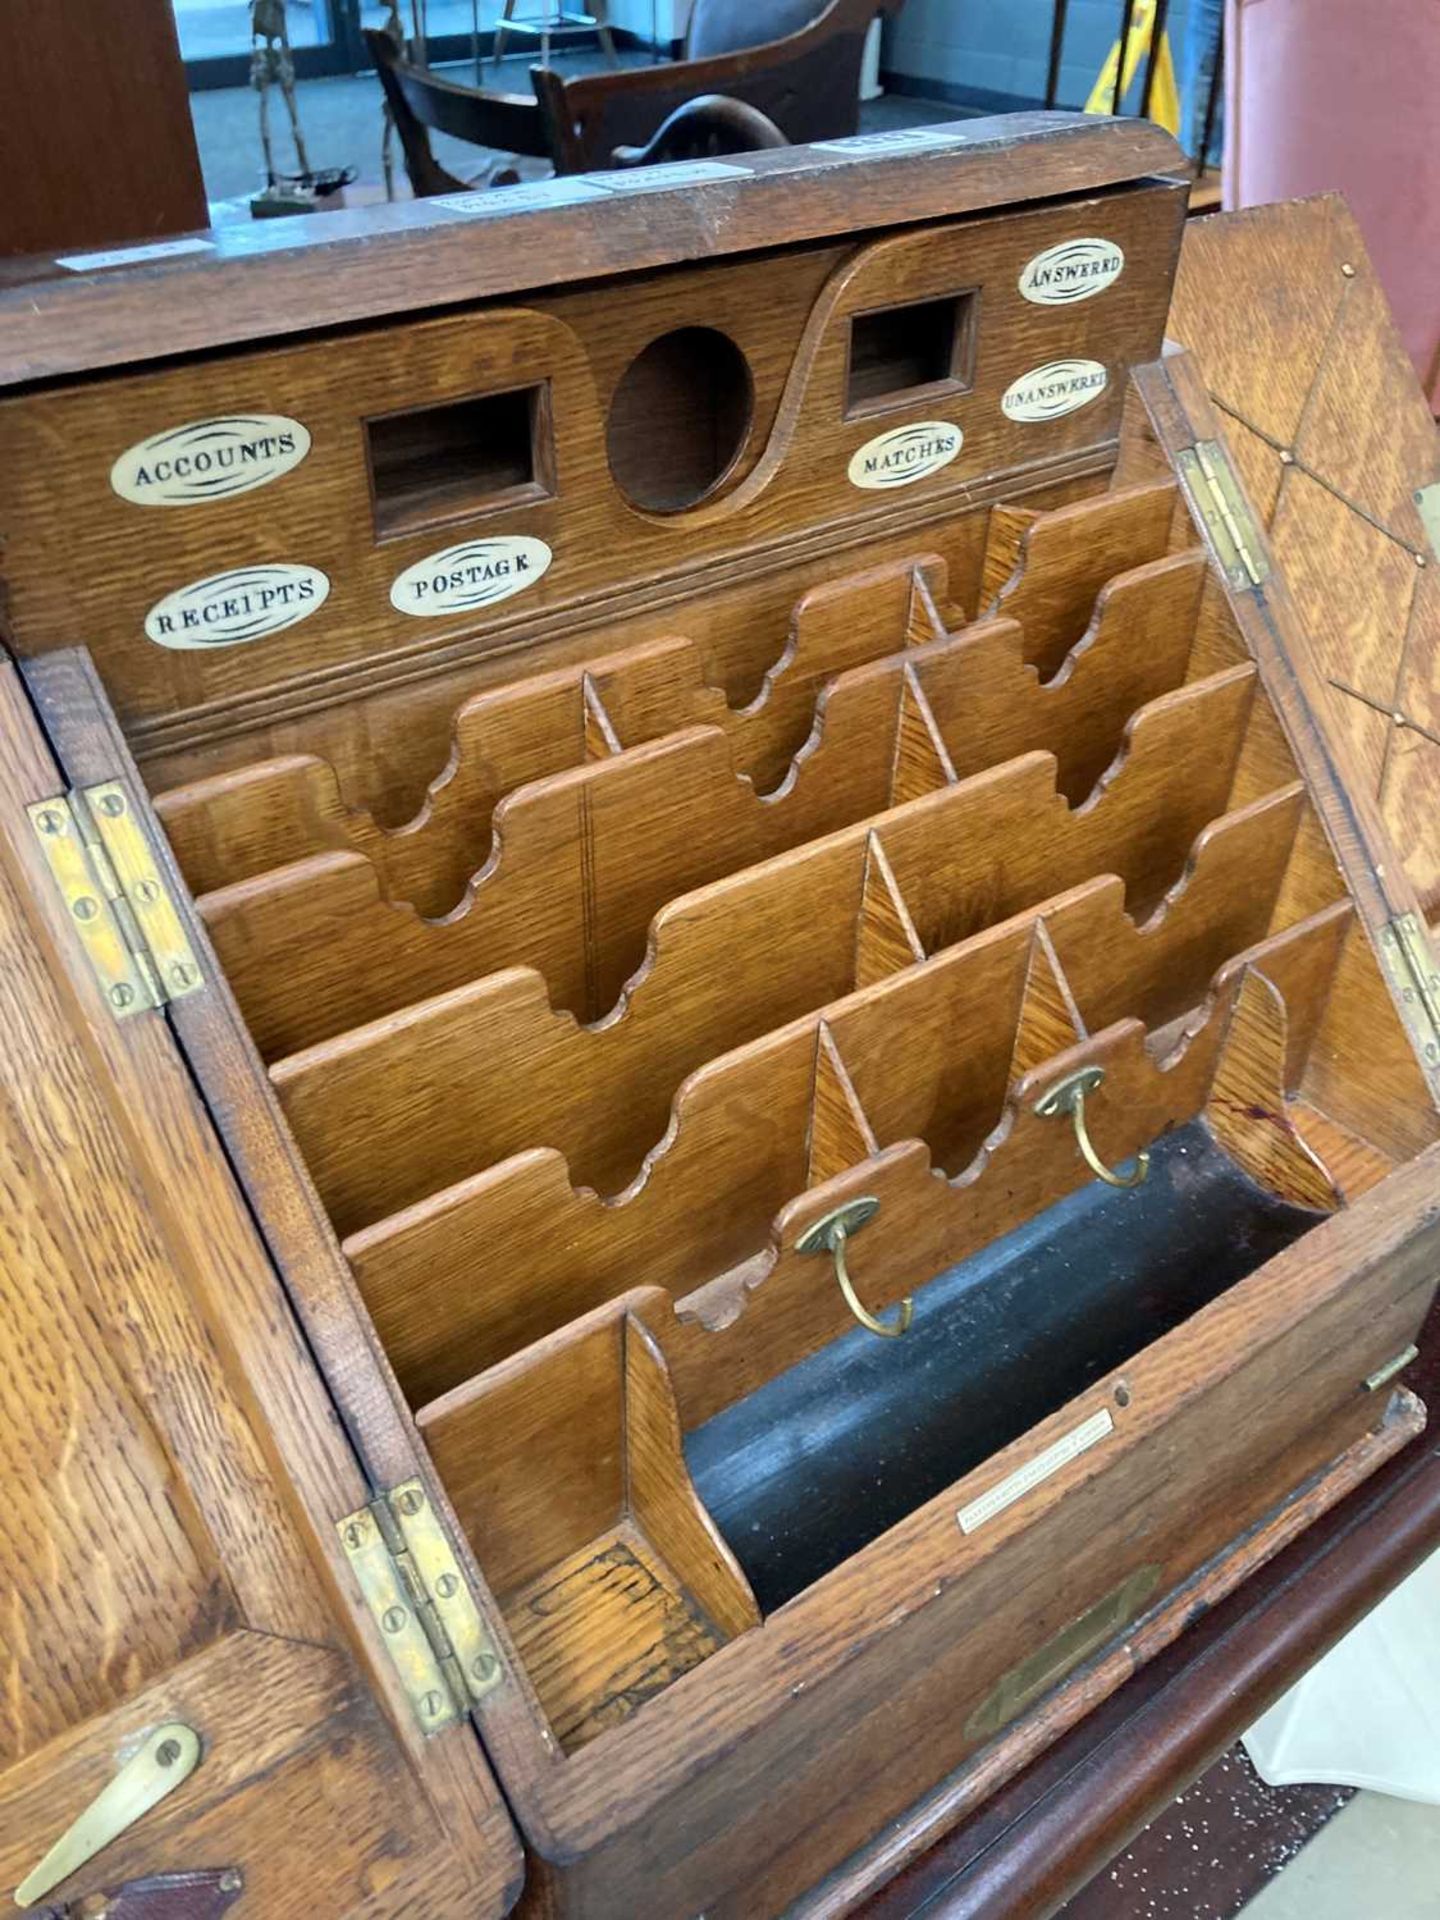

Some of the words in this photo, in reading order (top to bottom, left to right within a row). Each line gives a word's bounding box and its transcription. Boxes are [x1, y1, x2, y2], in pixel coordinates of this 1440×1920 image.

[1029, 256, 1120, 288] ANSWERED
[135, 432, 297, 487] ACCOUNTS
[864, 436, 955, 473] MATCHES
[156, 577, 316, 635] RECEIPTS
